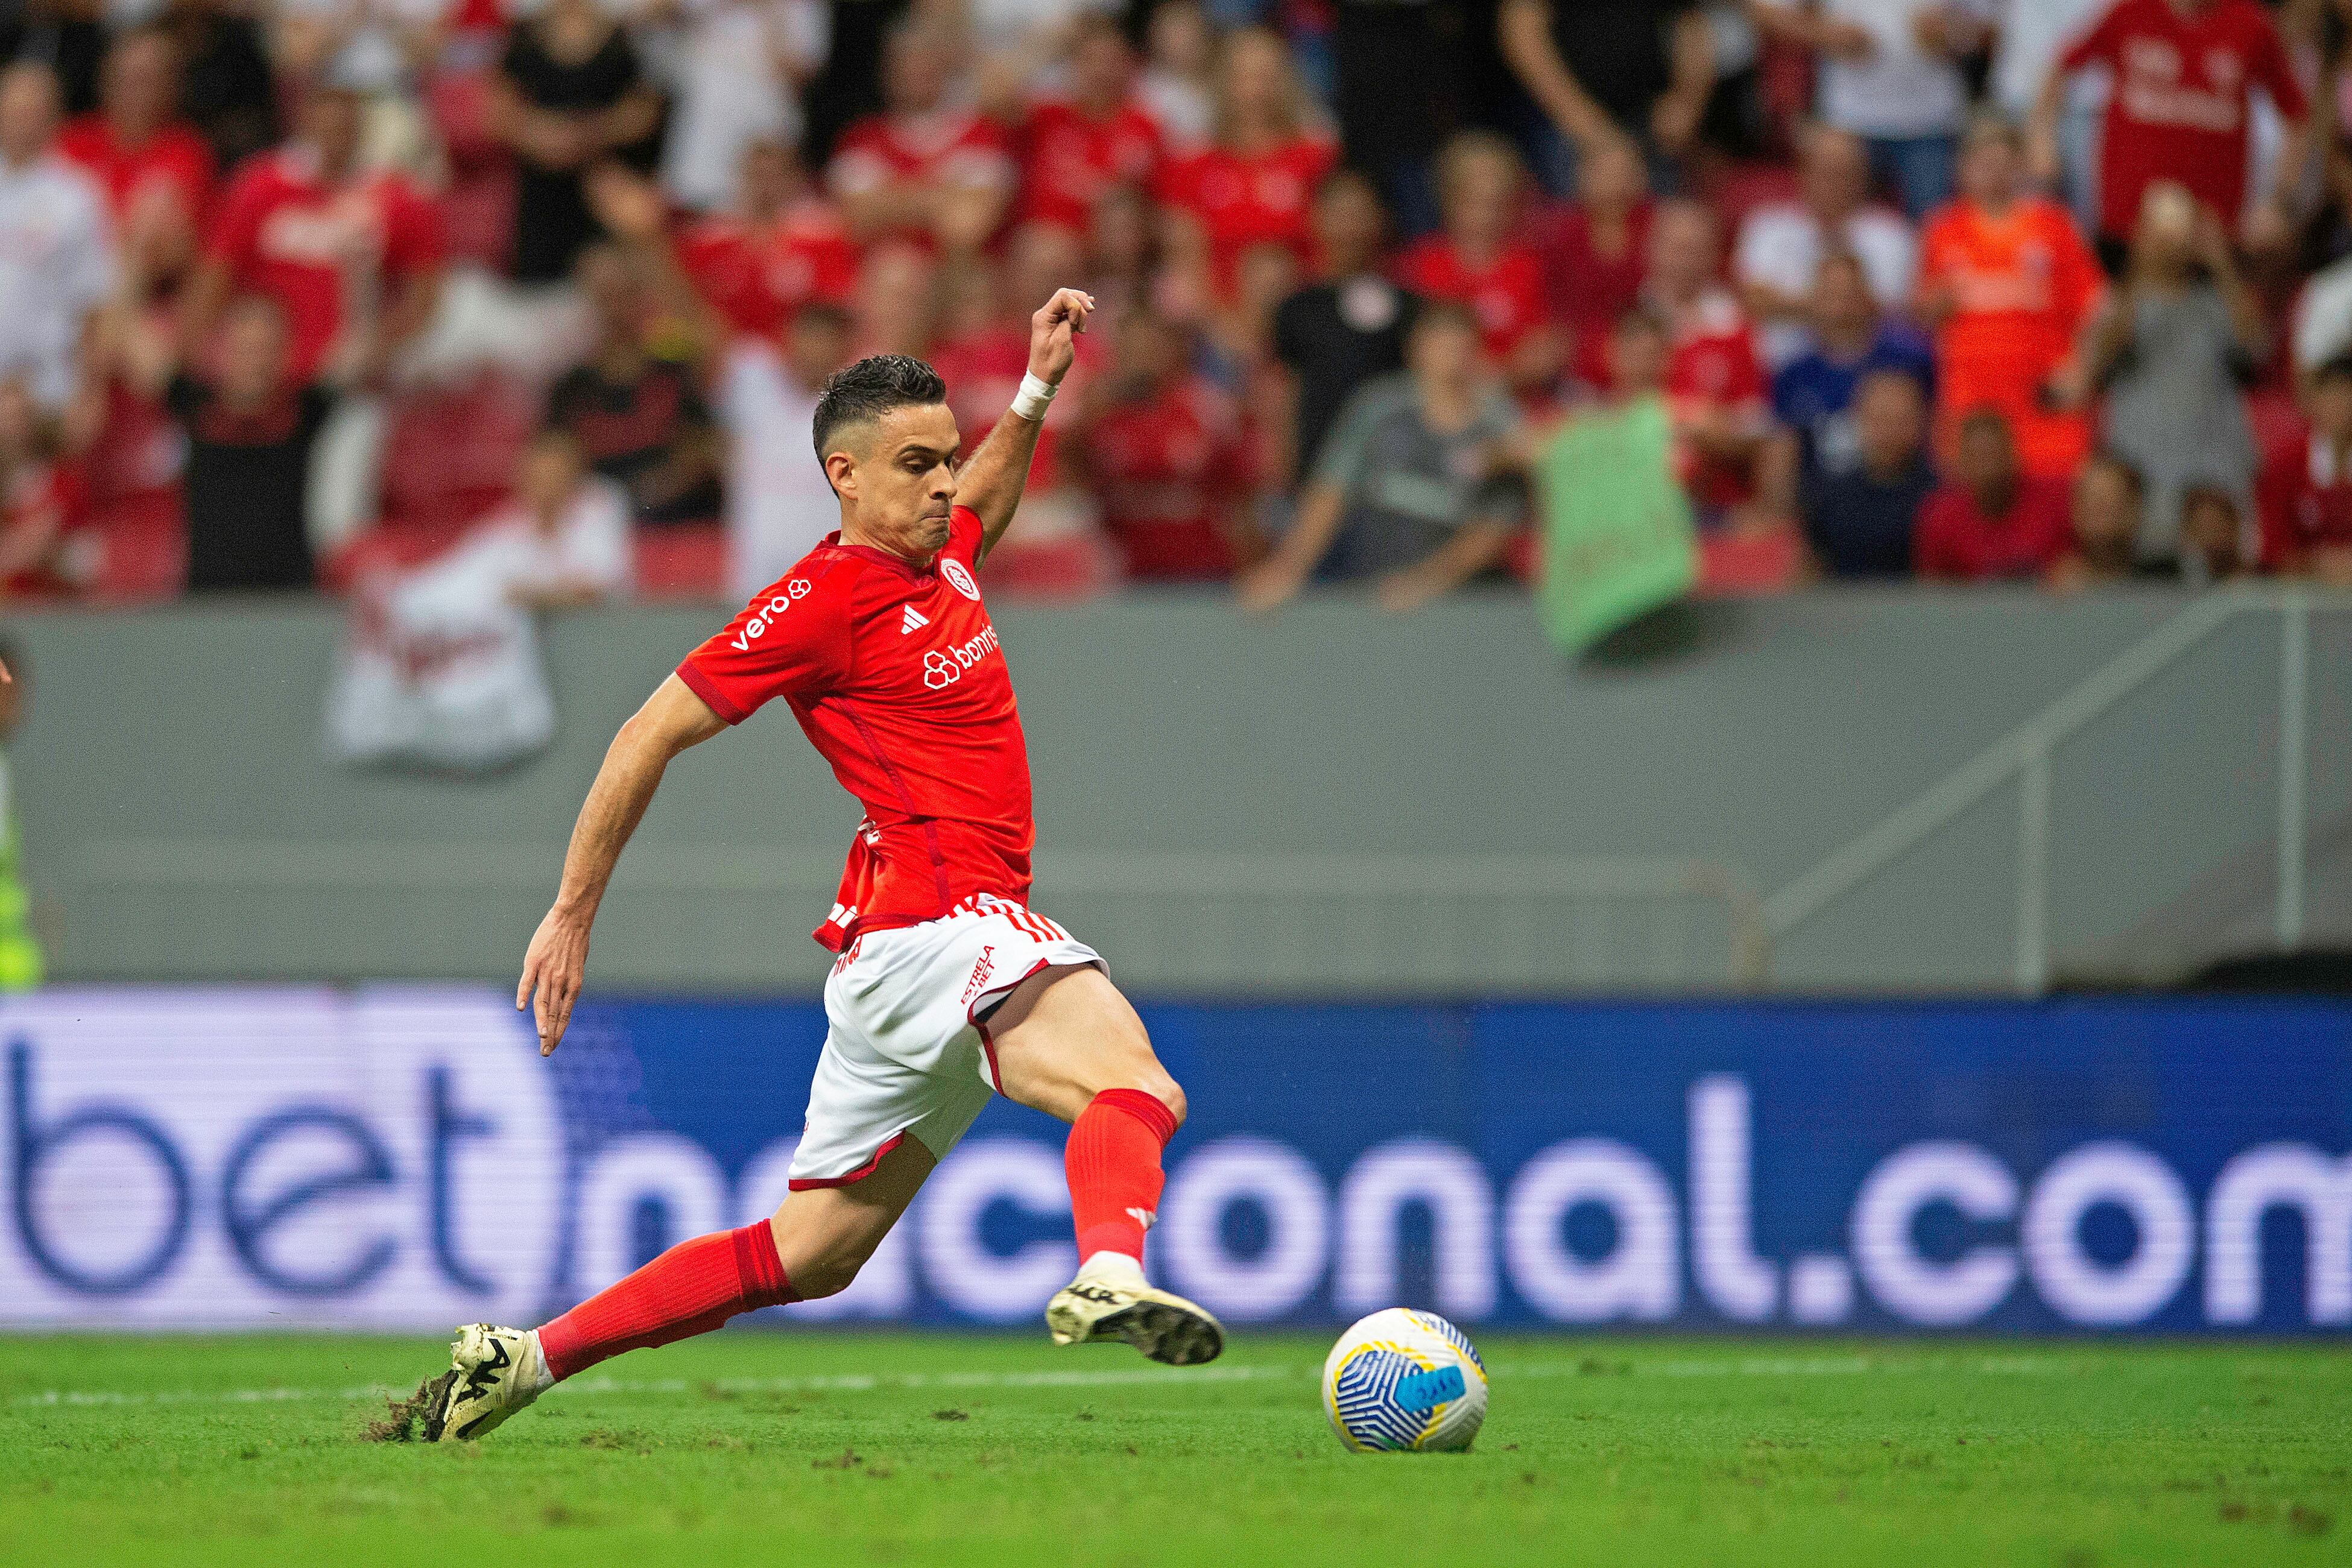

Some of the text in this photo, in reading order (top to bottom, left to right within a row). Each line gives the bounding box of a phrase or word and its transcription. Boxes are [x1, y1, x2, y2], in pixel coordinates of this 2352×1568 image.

[731, 596, 790, 651] vero
[961, 946, 995, 1005] ESTRELA
[977, 961, 995, 988] BET
